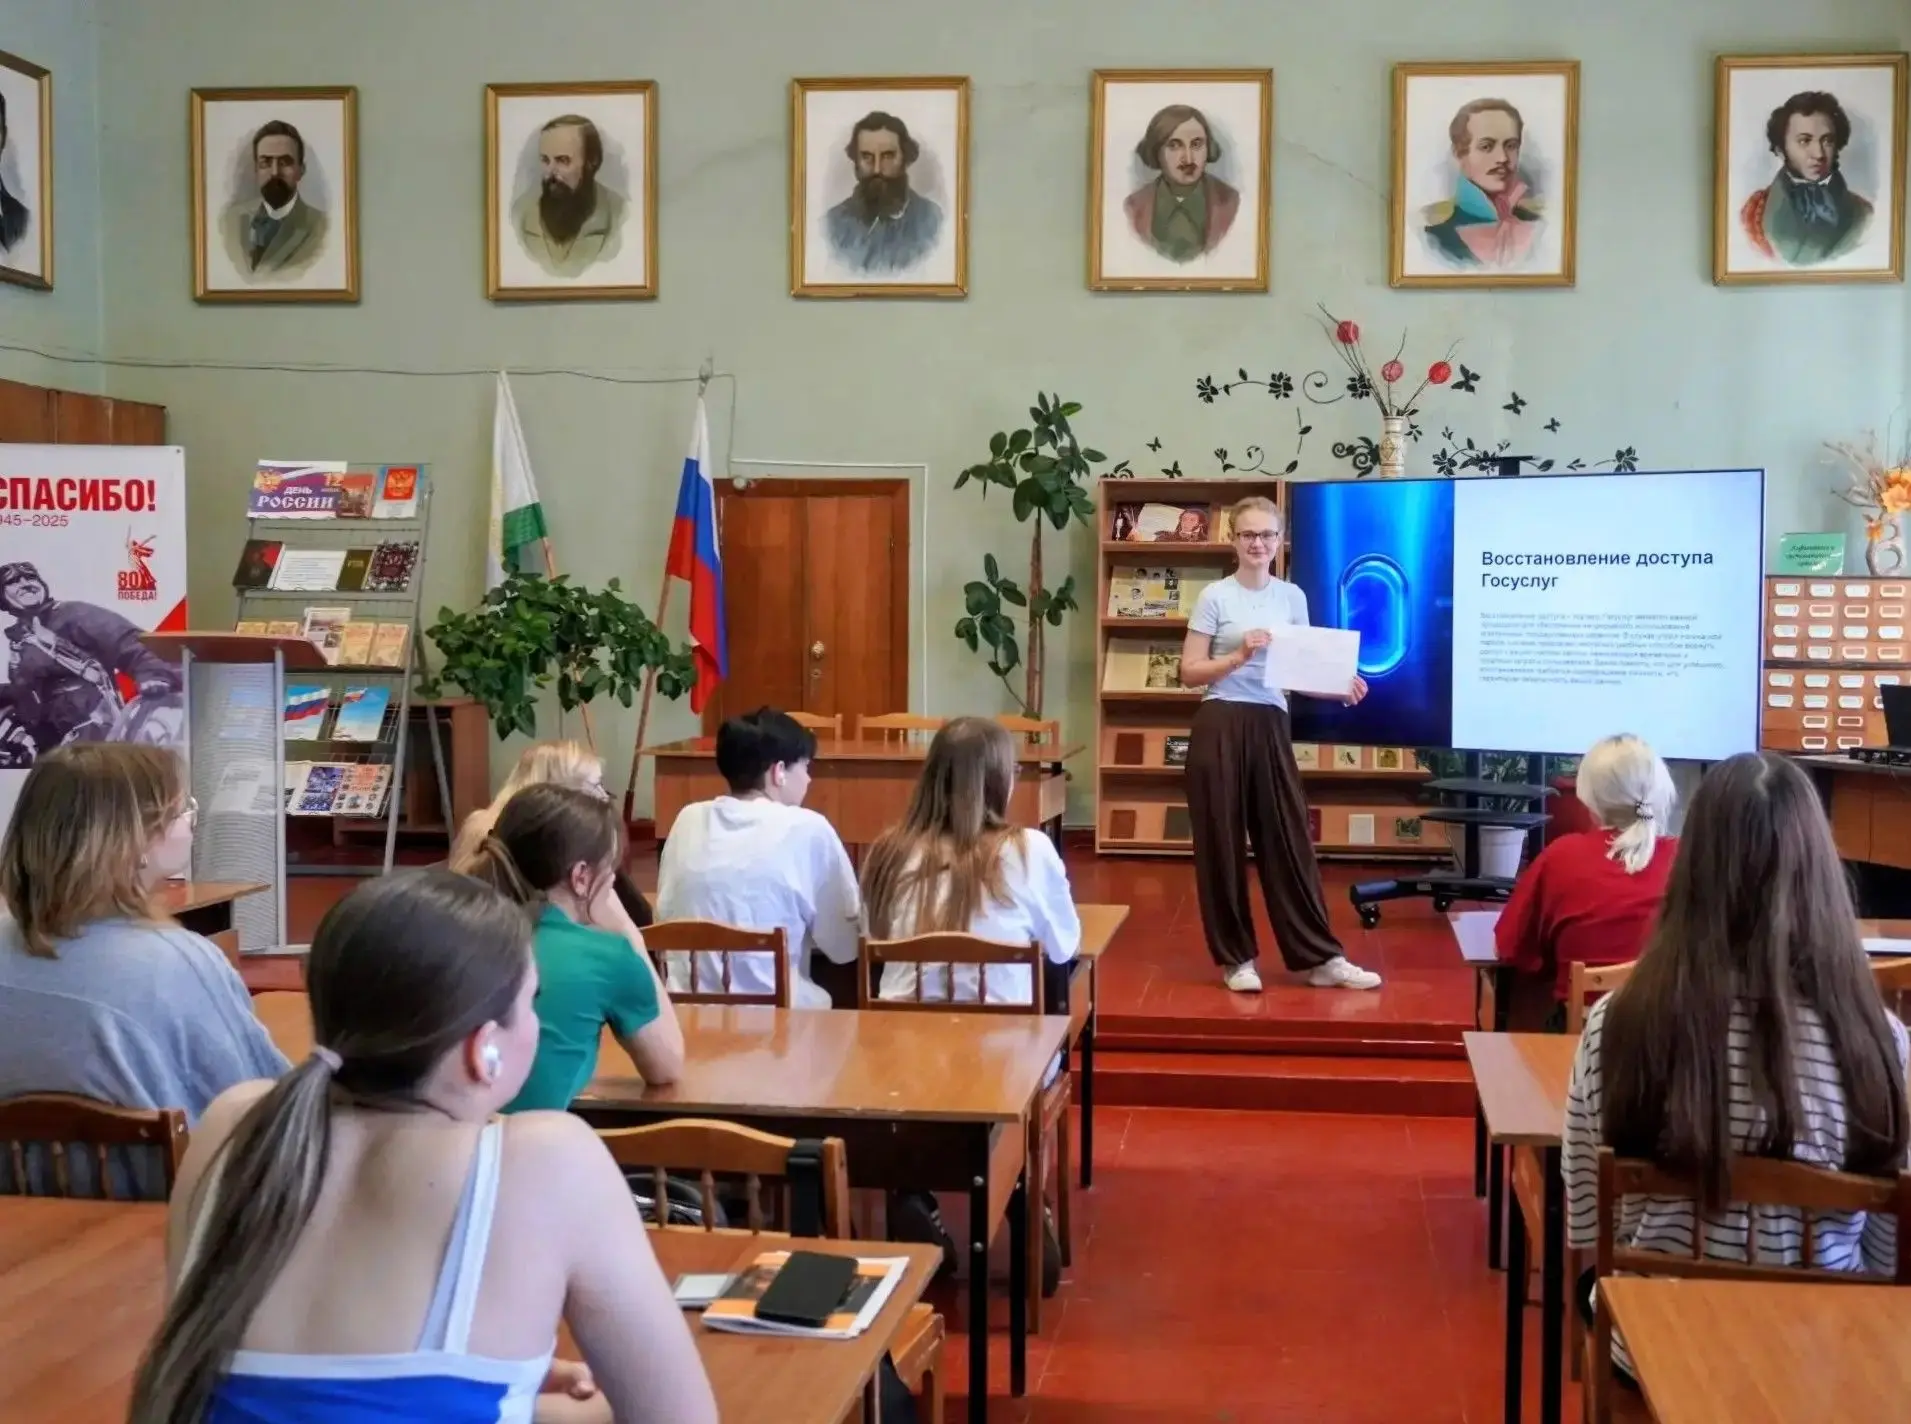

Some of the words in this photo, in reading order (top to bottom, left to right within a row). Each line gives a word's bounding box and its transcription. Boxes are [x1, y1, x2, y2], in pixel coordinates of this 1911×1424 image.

[284, 486, 313, 495] ДЕНЬ
[257, 495, 334, 509] РОССИИ
[1482, 551, 1631, 566] Восстановление
[1636, 552, 1714, 568] доступа
[1482, 573, 1559, 591] Госуслуг
[117, 591, 157, 601] ПОБЕДА!
